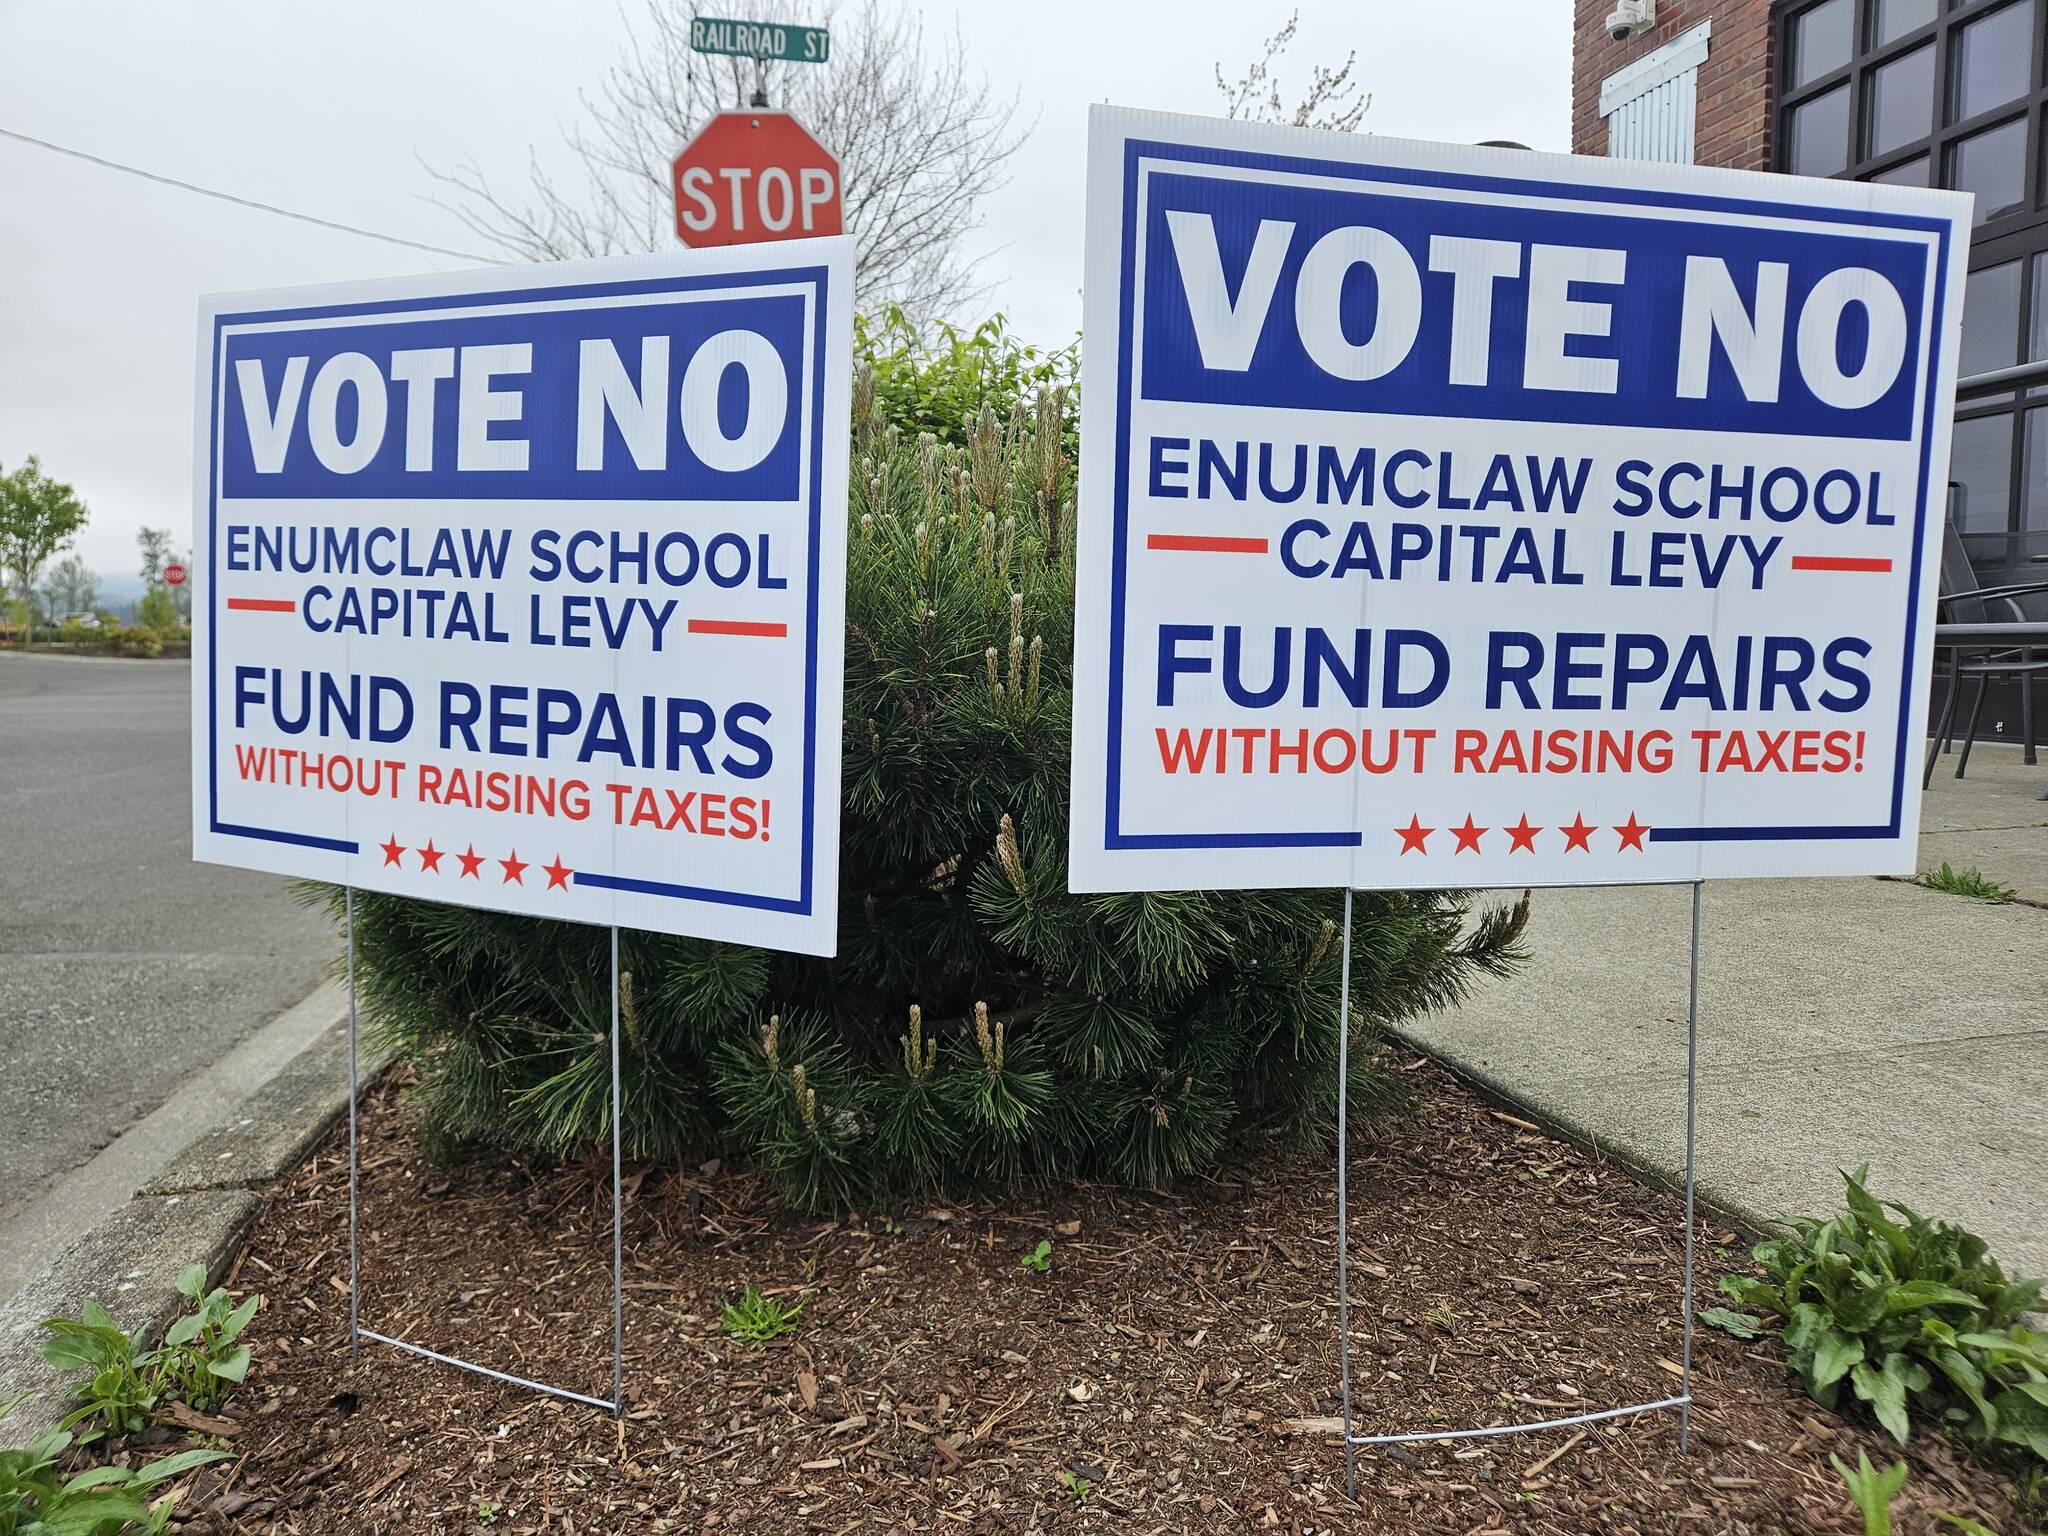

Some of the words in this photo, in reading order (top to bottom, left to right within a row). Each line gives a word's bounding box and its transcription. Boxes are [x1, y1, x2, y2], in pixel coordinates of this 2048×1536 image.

[692, 21, 786, 55] RAILROAD
[804, 31, 828, 59] ST
[681, 166, 834, 232] STOP
[1165, 211, 1627, 394] VOTE
[1676, 254, 1907, 410] NO
[235, 343, 533, 474] VOTE
[577, 329, 788, 472] NO
[1148, 436, 1593, 515] ENUMCLAW
[1612, 460, 1895, 526] SCHOOL
[227, 525, 512, 579] ENUMCLAW
[530, 530, 787, 589] SCHOOL
[1280, 519, 1583, 586] CAPITAL
[1612, 531, 1783, 590] LEVY
[303, 585, 509, 642] CAPITAL
[531, 594, 678, 651] LEVY
[1156, 624, 1450, 708] FUND
[1487, 631, 1872, 713] REPAIRS
[235, 666, 414, 743] FUND
[440, 681, 774, 779] REPAIRS
[1155, 728, 1436, 774] WITHOUT
[1455, 729, 1674, 774] RAISING
[1691, 729, 1864, 773] TAXES!
[235, 744, 405, 799] WITHOUT
[419, 765, 591, 820] RAISING
[607, 783, 771, 842] TAXES!
